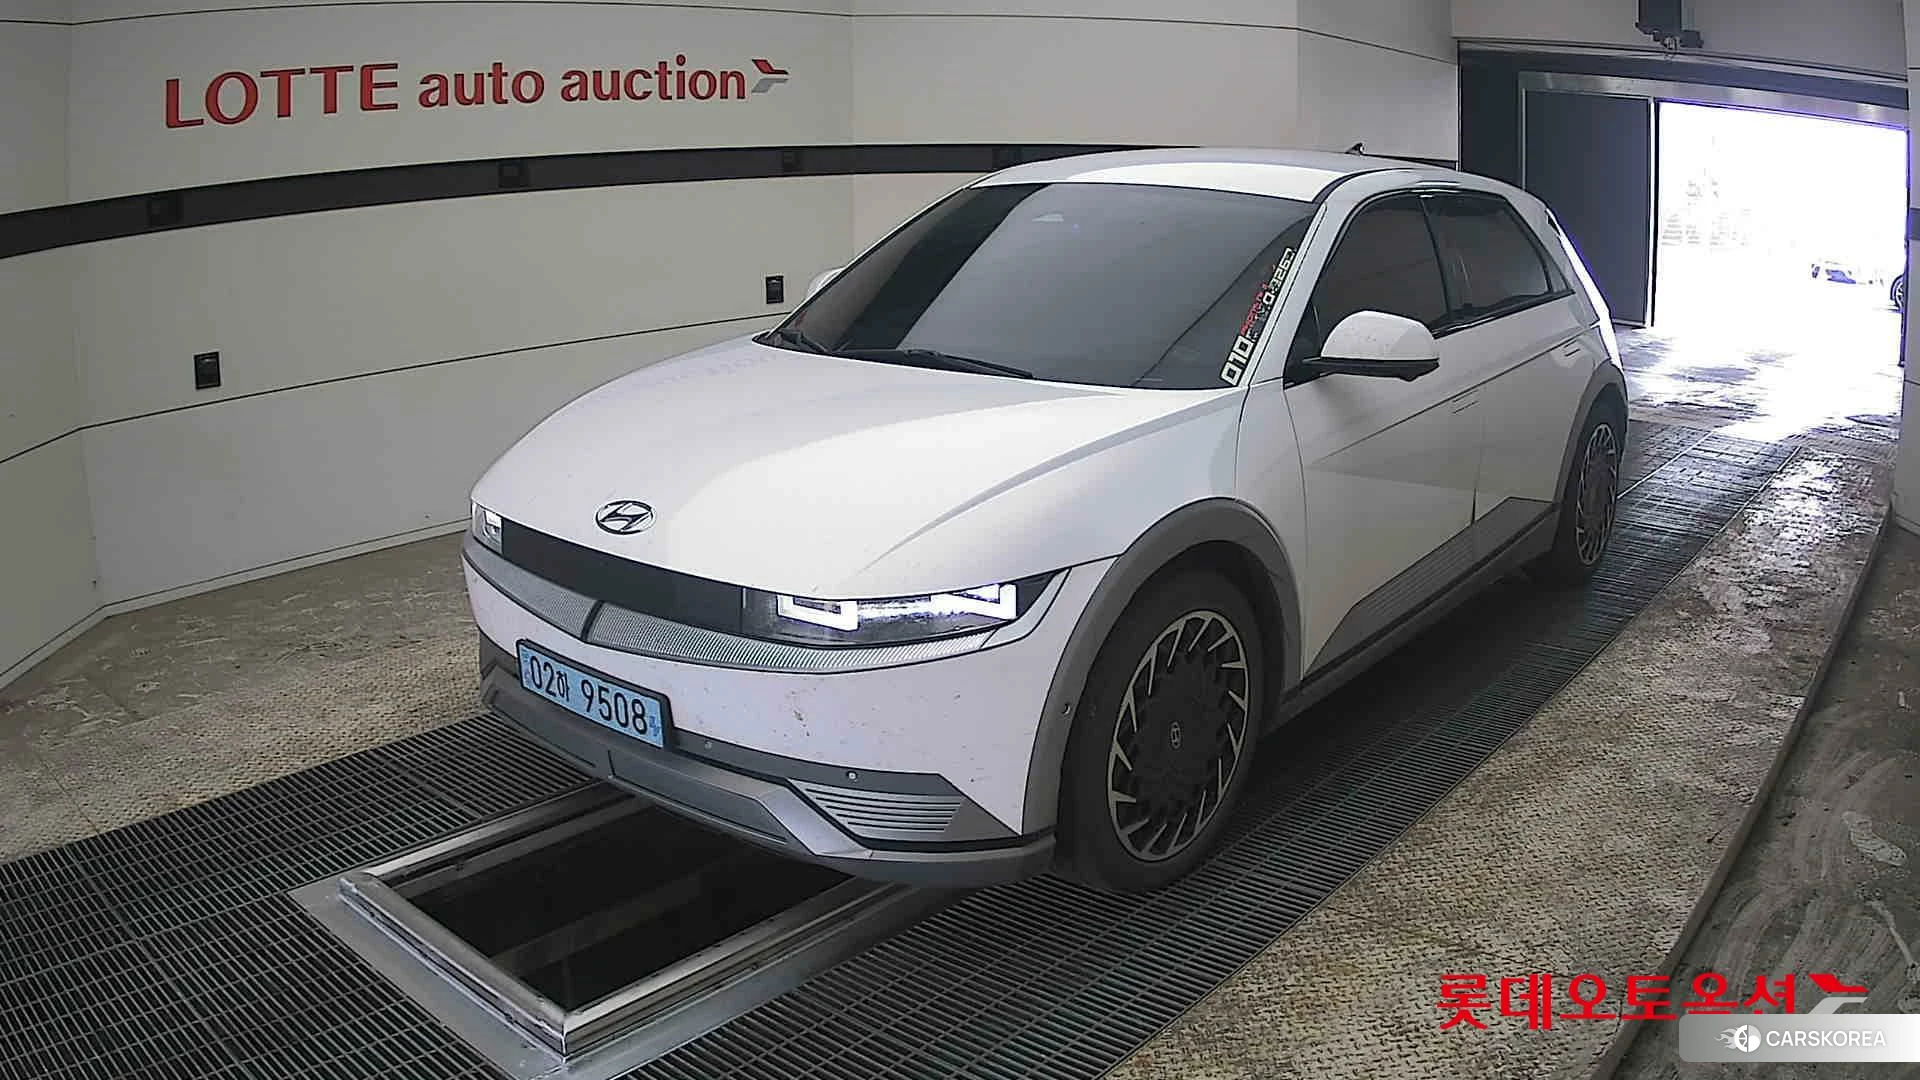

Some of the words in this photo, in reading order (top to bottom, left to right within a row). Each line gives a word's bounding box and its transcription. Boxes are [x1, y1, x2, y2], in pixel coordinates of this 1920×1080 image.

[165, 63, 399, 128] LOTTE
[419, 63, 546, 108] auto
[561, 55, 746, 102] auction
[530, 655, 570, 702] 02하
[581, 679, 648, 735] 9508
